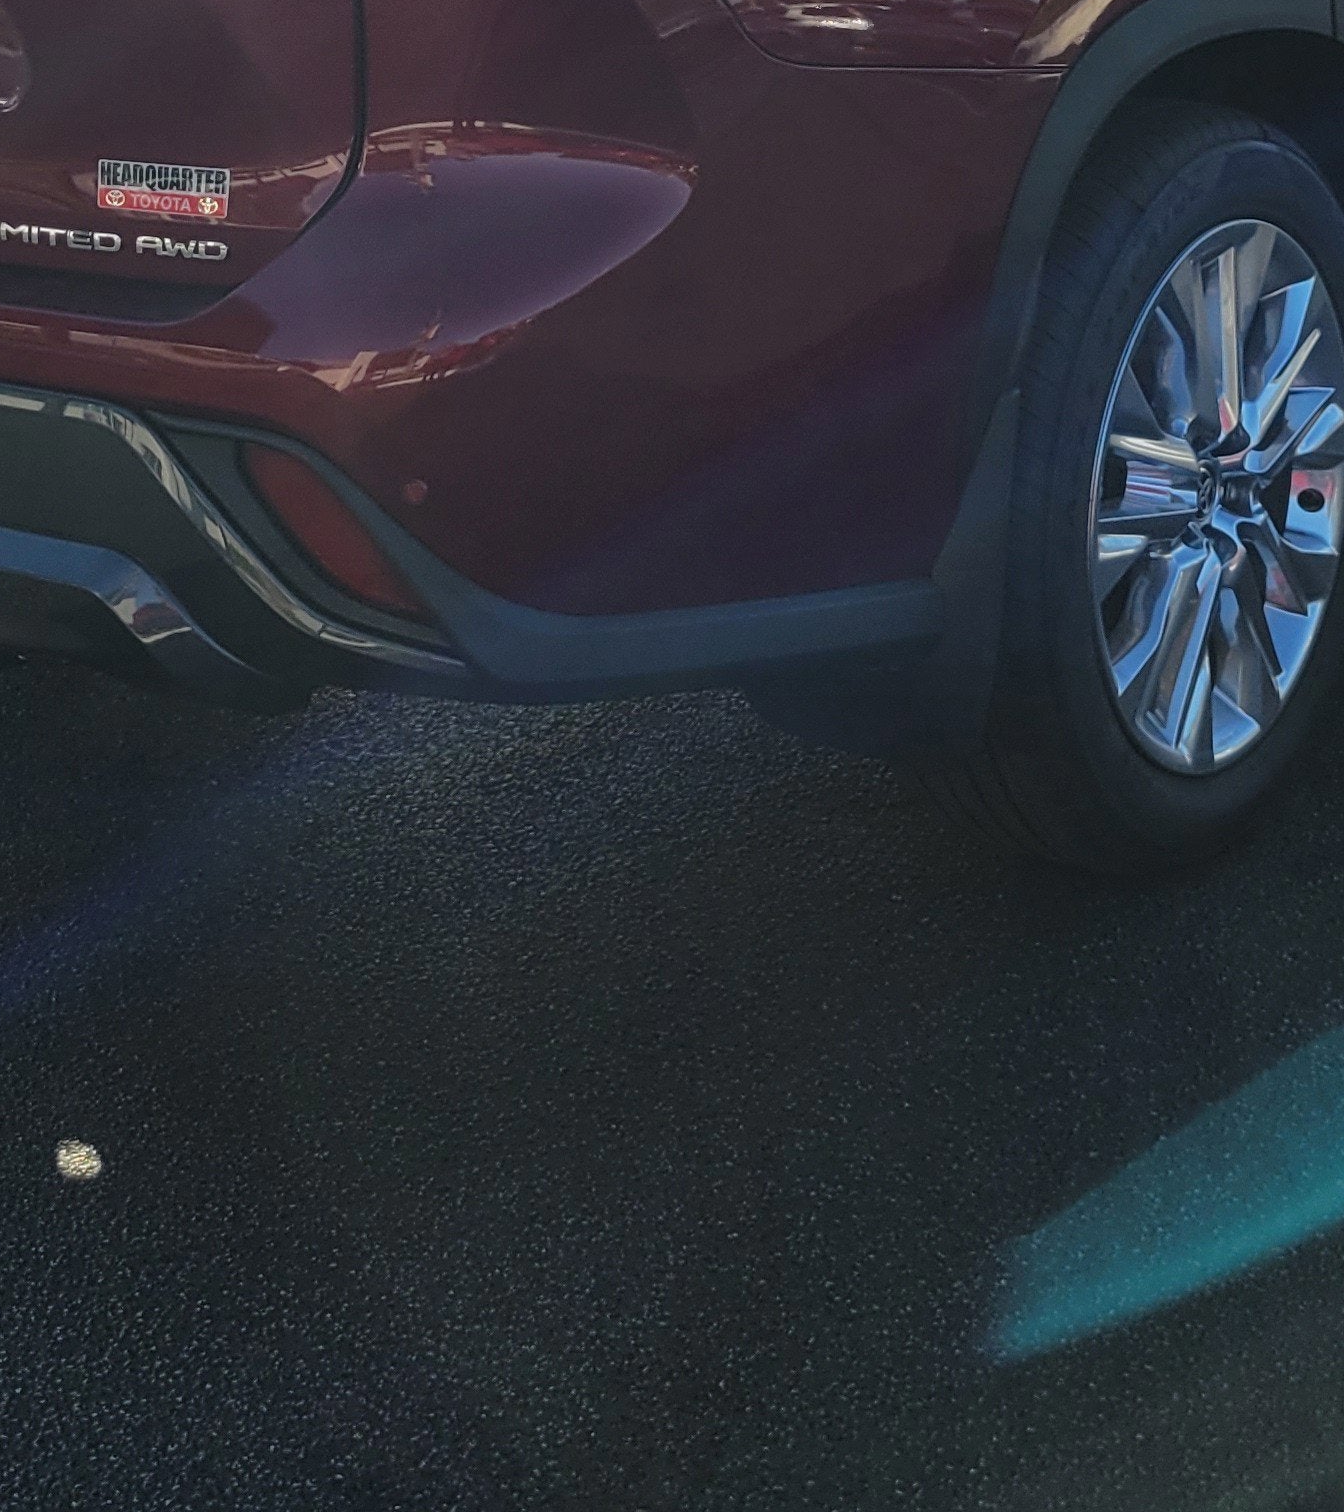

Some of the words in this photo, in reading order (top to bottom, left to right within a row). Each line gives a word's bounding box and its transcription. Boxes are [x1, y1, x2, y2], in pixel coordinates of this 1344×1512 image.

[100, 160, 228, 195] HEADQUARTER
[130, 193, 192, 213] TOYOTA
[135, 234, 229, 261] AWD
